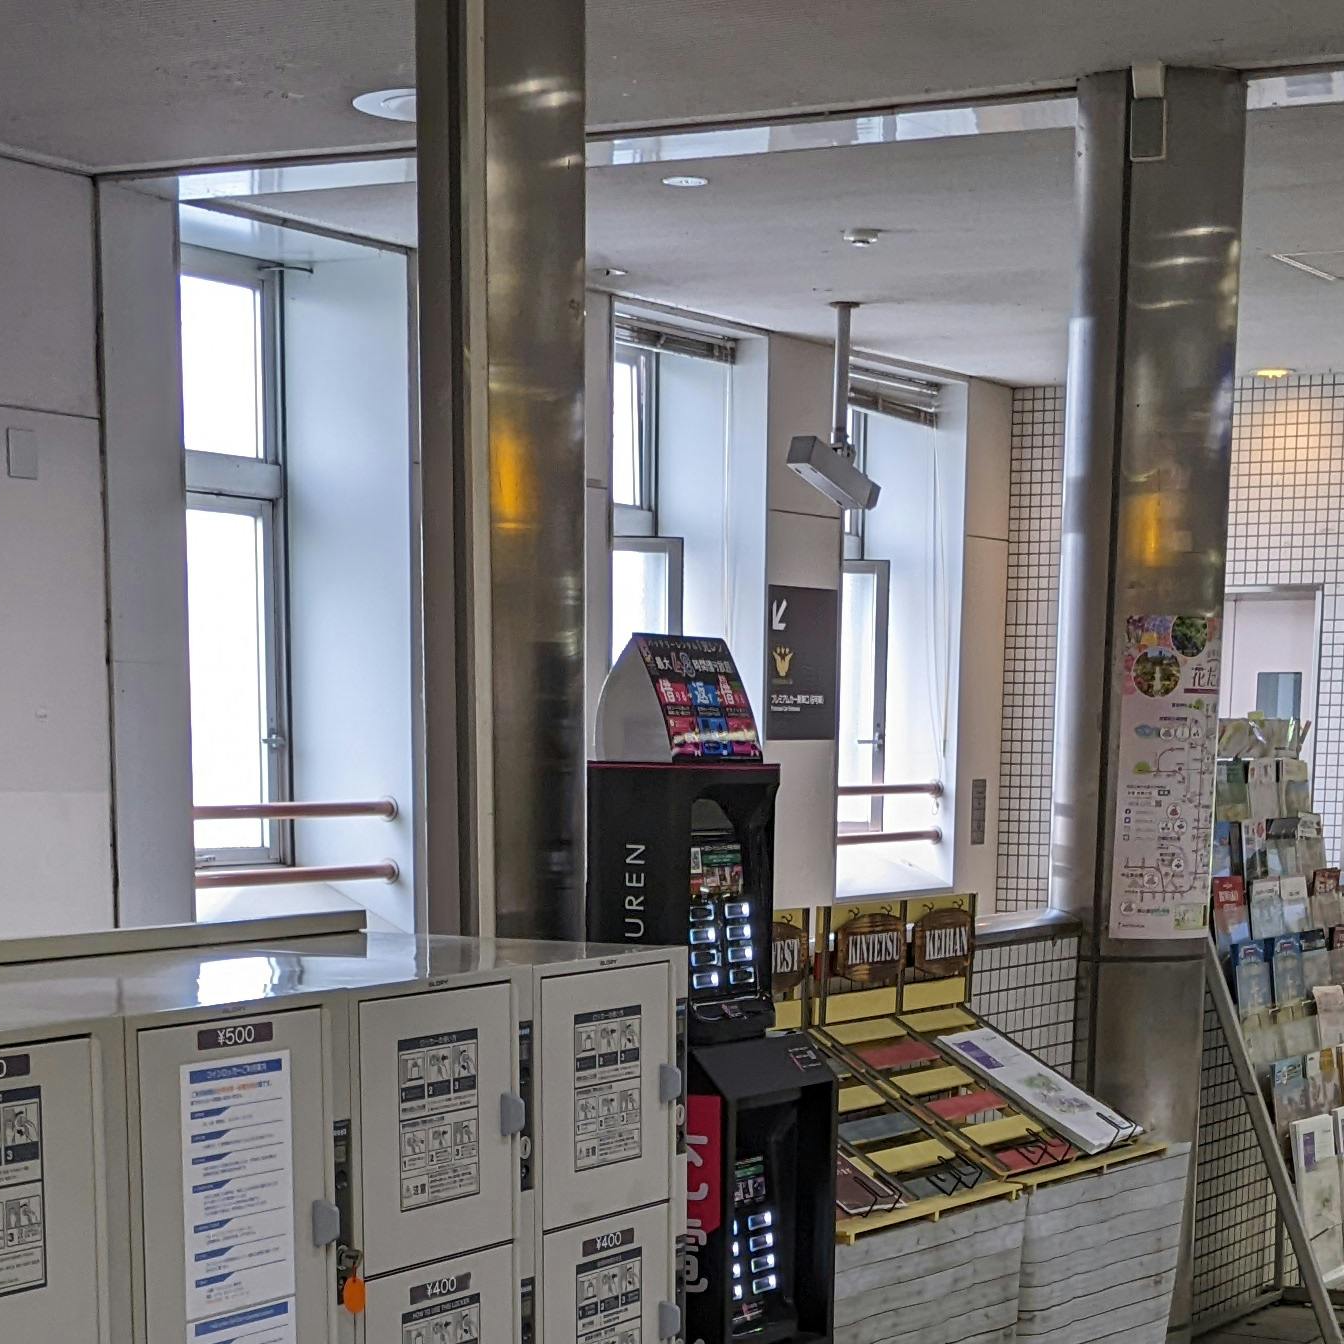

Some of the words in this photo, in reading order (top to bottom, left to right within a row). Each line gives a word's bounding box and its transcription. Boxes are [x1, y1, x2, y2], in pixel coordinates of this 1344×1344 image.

[848, 931, 901, 966] KINTETSU
[925, 927, 969, 961] KEIHAN
[217, 1026, 255, 1045] ¥500
[596, 1231, 622, 1251] ¥400
[426, 1276, 457, 1297] ¥400
